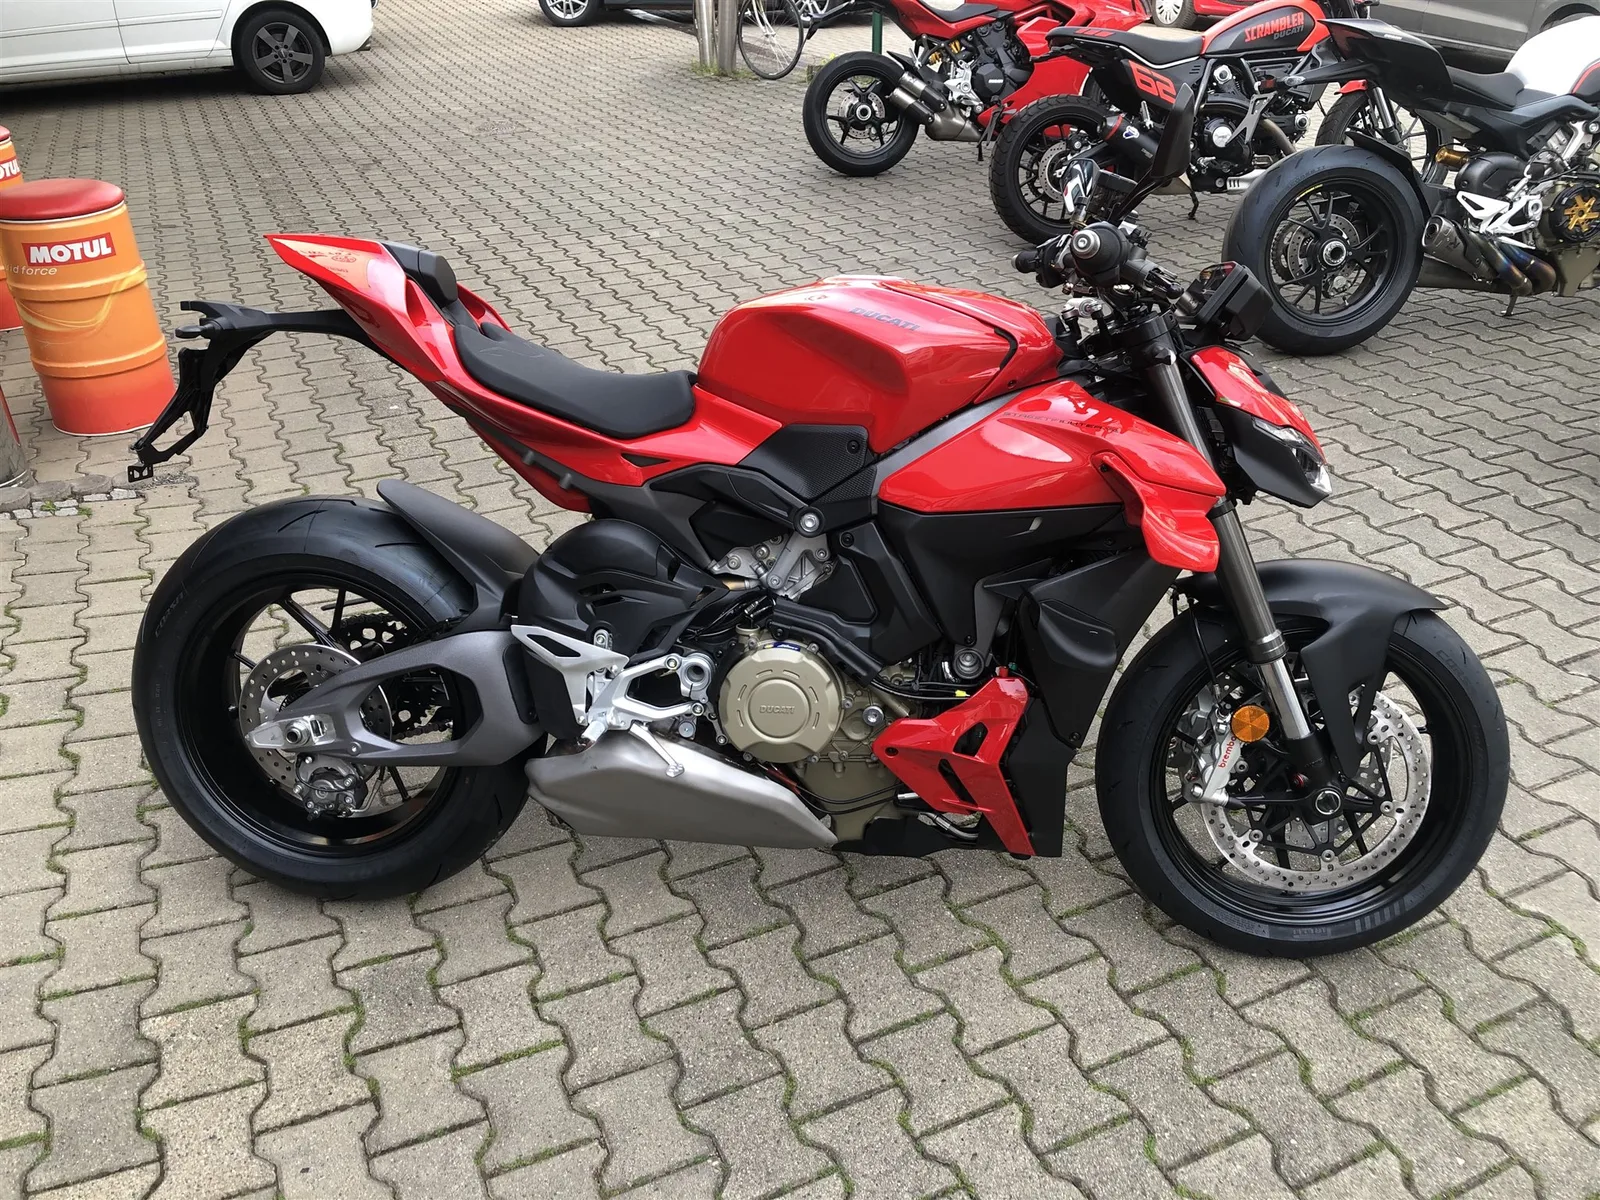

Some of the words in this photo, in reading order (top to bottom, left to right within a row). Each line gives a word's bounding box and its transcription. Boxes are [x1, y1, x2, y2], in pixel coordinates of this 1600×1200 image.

[1244, 11, 1304, 42] SCRAMBLER
[1273, 25, 1304, 40] DUCATI
[1128, 59, 1177, 104] 62
[29, 237, 112, 264] MOTUL
[21, 265, 58, 276] force
[848, 307, 921, 331] DUCATI
[759, 704, 796, 714] DUCATI
[1218, 736, 1237, 769] brembo
